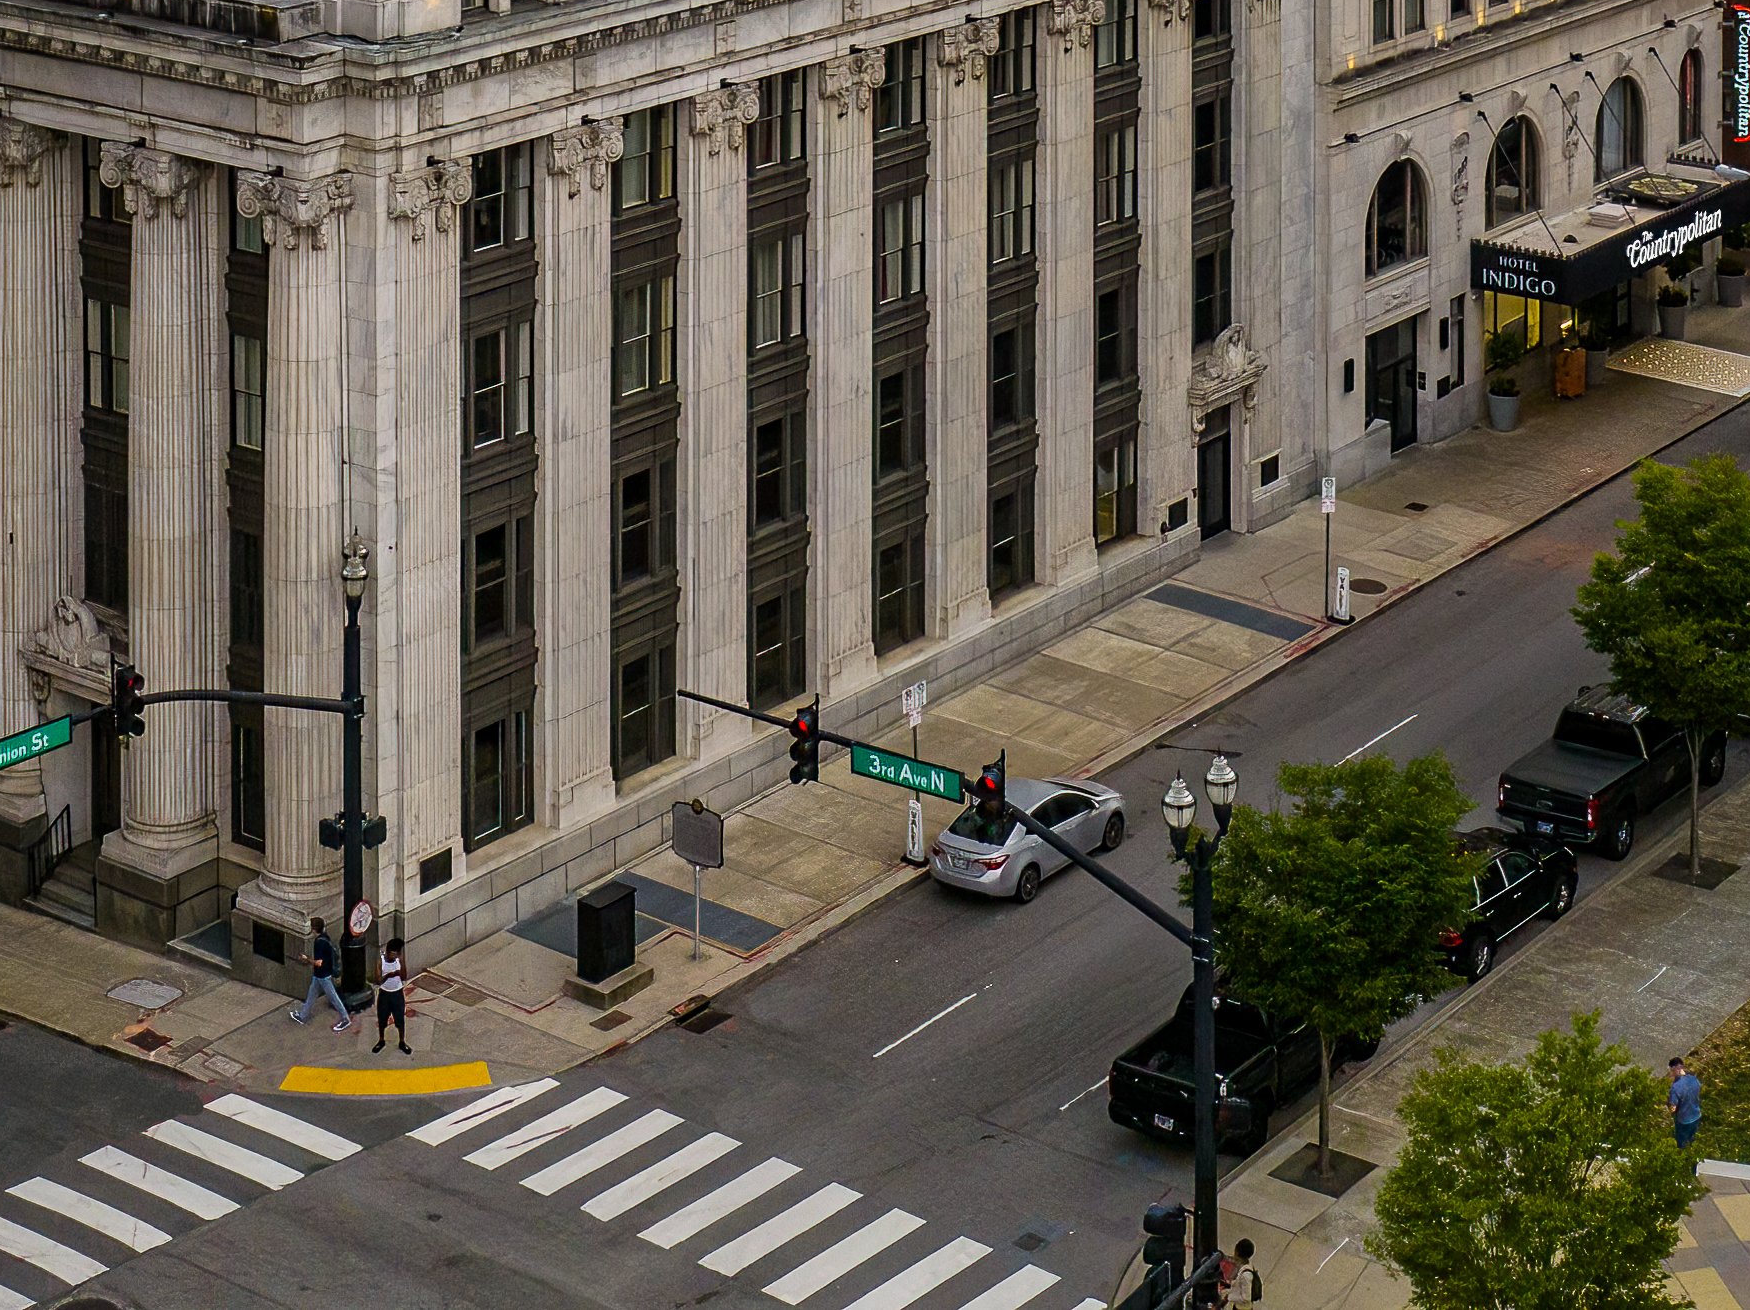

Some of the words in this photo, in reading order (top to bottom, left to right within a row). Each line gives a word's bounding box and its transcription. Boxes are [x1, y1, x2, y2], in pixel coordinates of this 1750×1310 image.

[1626, 208, 1722, 268] Countrypolitan
[1642, 230, 1654, 244] The
[1499, 255, 1539, 273] HOTEL
[1482, 268, 1556, 296] INDIGO
[31, 732, 49, 751] St
[869, 754, 895, 779] 3rd
[899, 763, 927, 788] Ave
[931, 769, 945, 793] N
